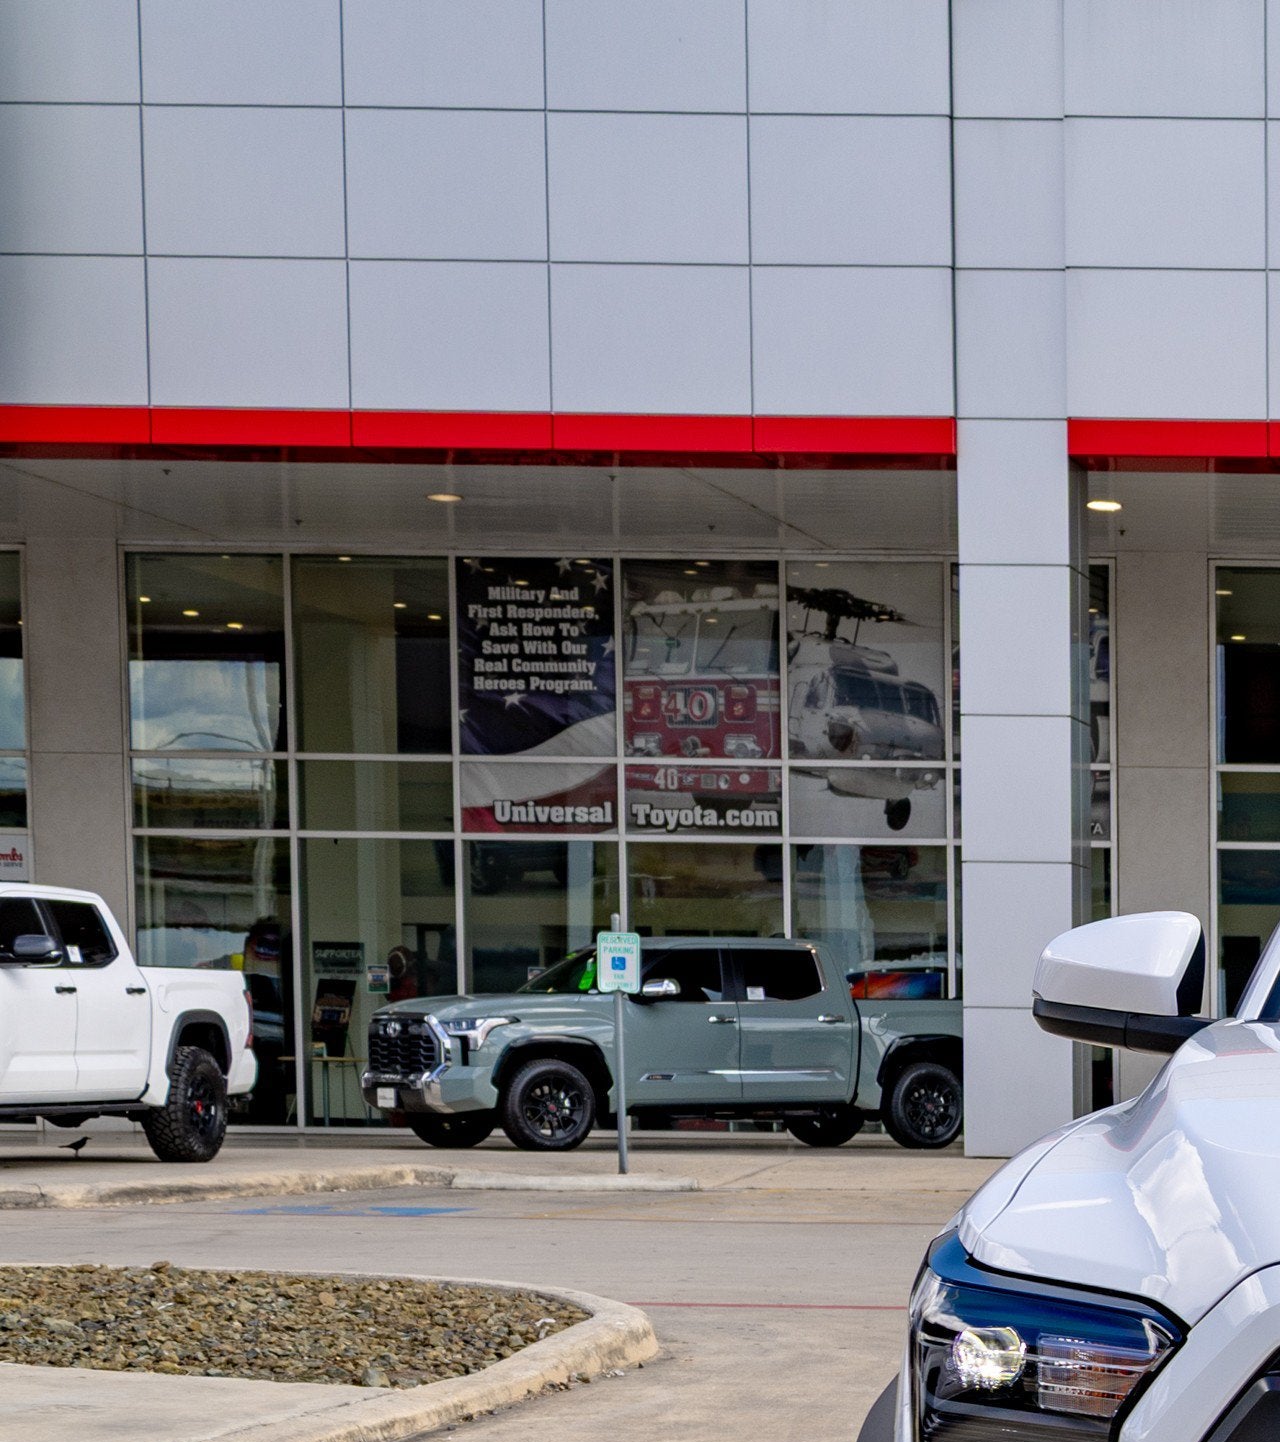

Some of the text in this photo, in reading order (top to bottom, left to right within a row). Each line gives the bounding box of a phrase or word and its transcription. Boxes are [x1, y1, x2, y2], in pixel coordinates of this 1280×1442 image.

[487, 586, 579, 603] Military And
[468, 604, 599, 621] First Responders,
[489, 622, 579, 637] Ask How To
[482, 640, 588, 655] Save With Our
[474, 658, 597, 676] Real Community
[473, 676, 598, 694] Heroes Program.
[663, 690, 716, 722] 40
[653, 767, 679, 790] 40
[494, 800, 780, 833] Universal Toyota.com
[603, 946, 634, 955] PARKING
